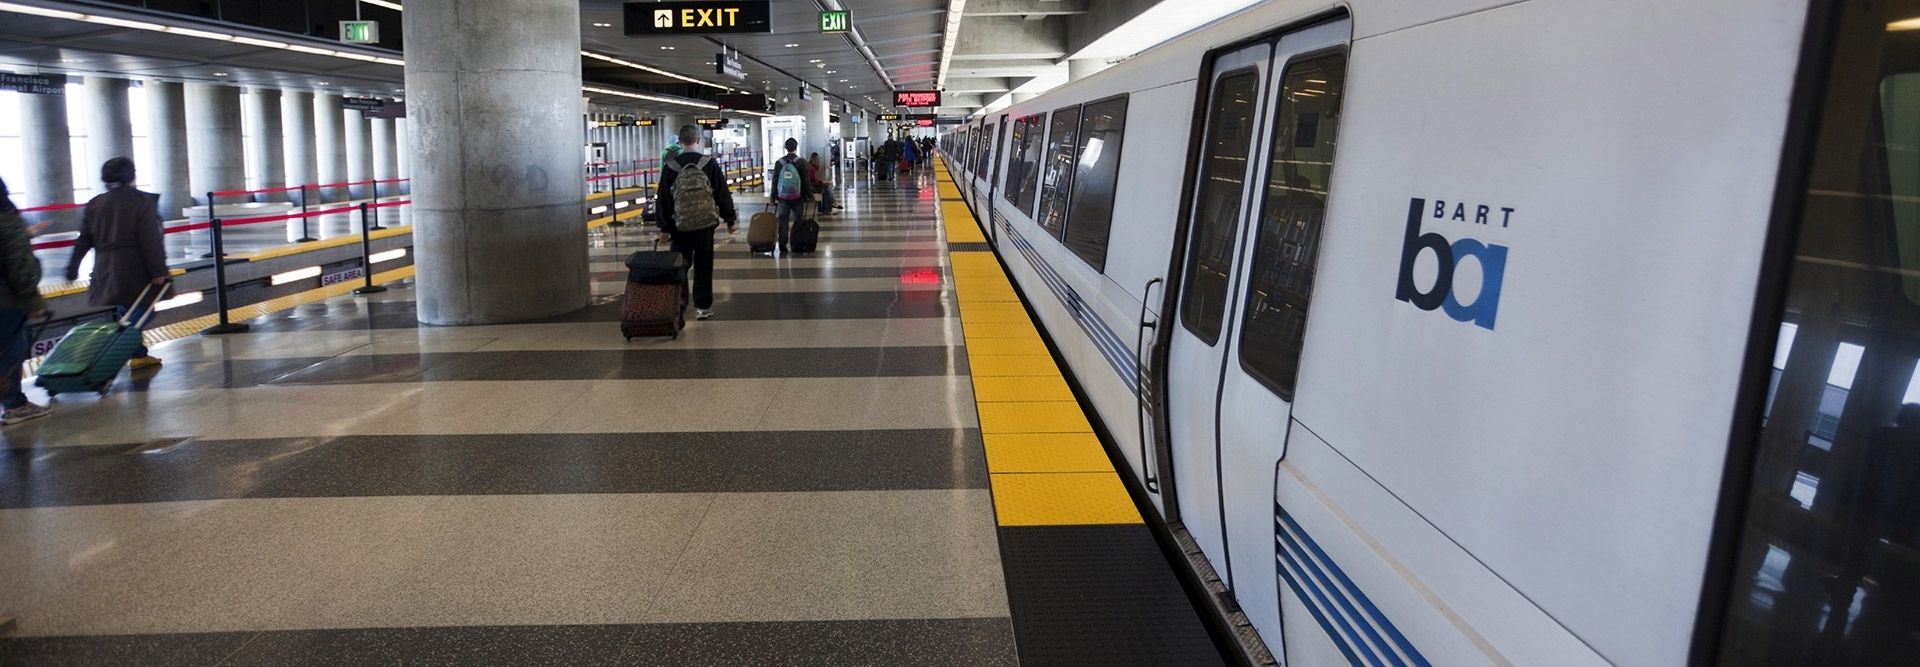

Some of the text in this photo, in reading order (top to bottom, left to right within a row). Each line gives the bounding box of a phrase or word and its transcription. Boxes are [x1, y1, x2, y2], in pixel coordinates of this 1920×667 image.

[681, 8, 740, 28] EXIT
[822, 12, 847, 30] EXIT
[0, 74, 49, 85] Francisco
[32, 85, 66, 95] Airport
[1433, 199, 1515, 228] BART
[1395, 197, 1509, 331] ba
[325, 269, 361, 285] SAFE AREA
